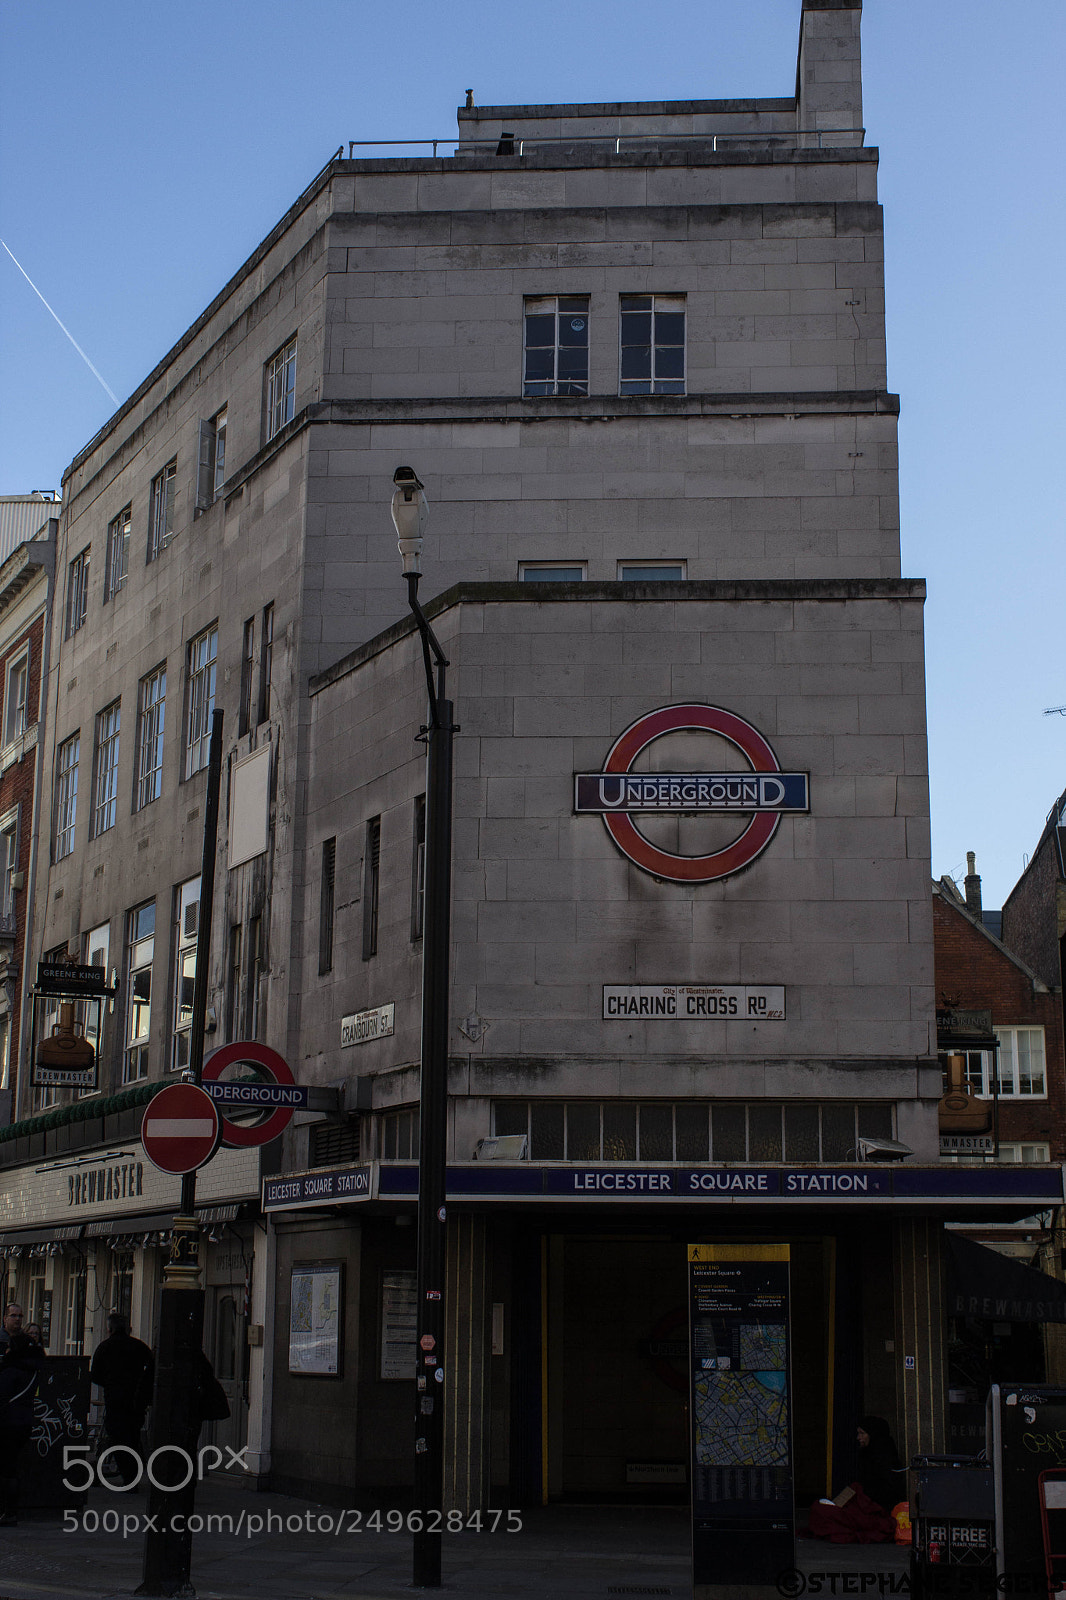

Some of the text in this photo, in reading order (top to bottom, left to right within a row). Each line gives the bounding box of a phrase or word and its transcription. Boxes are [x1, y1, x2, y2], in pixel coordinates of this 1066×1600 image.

[599, 777, 785, 807] UNDERGROUND
[43, 969, 101, 980] GREENE KING
[663, 987, 676, 996] City
[607, 996, 676, 1015] CHARING
[686, 996, 738, 1015] CROSS
[748, 996, 767, 1015] RD
[936, 1016, 988, 1026] ENE KING
[342, 1017, 378, 1044] CRANBOURN
[37, 1071, 93, 1082] BREWMASTER
[202, 1085, 303, 1103] NDERGROUND
[939, 1136, 992, 1149] WMASTER
[68, 1162, 144, 1206] BREWMASTER
[268, 1173, 369, 1200] LEICESTER SQUARE STATION
[573, 1173, 868, 1192] LEICESTER SQUARE STATION
[952, 1527, 987, 1542] FREE
